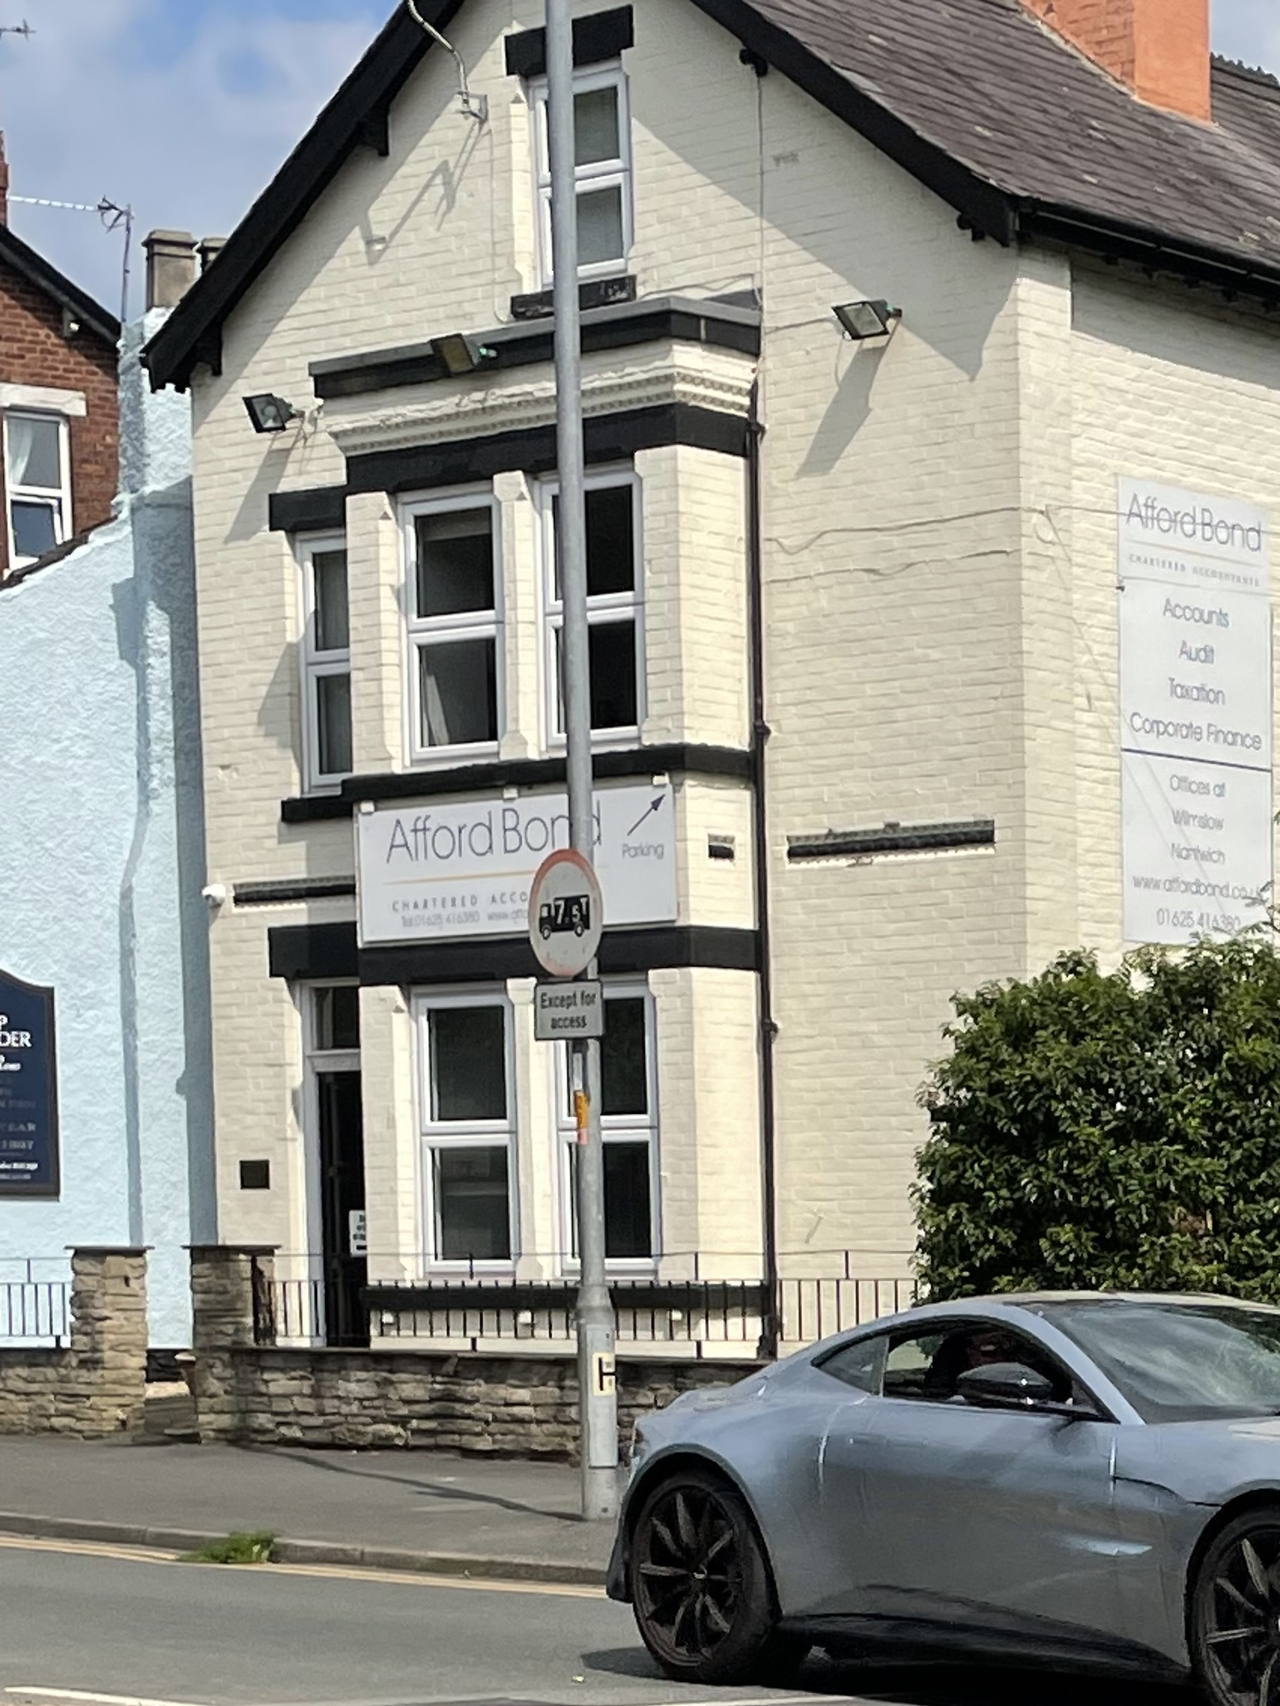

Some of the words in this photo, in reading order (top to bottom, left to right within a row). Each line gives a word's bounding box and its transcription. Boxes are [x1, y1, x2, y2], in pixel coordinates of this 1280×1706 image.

[1126, 492, 1197, 538] Afford
[1201, 507, 1262, 552] Bond
[1129, 554, 1186, 573] CHARTERED
[1163, 597, 1230, 629] Accounts
[1178, 640, 1215, 665] Audit
[1168, 676, 1226, 705] Taxation
[1130, 711, 1203, 742] Corporate
[1206, 722, 1262, 751] Finance
[1169, 773, 1211, 796] Offices
[1213, 782, 1227, 798] at
[1171, 809, 1225, 831] Wilmslow
[386, 810, 494, 863] Afford
[622, 843, 665, 860] Parking
[1171, 843, 1226, 865] Nantwich
[392, 894, 478, 912] CHARTERED
[1156, 907, 1195, 929] 01625
[541, 990, 577, 1010] Except
[580, 989, 596, 1007] for
[551, 1015, 588, 1029] access
